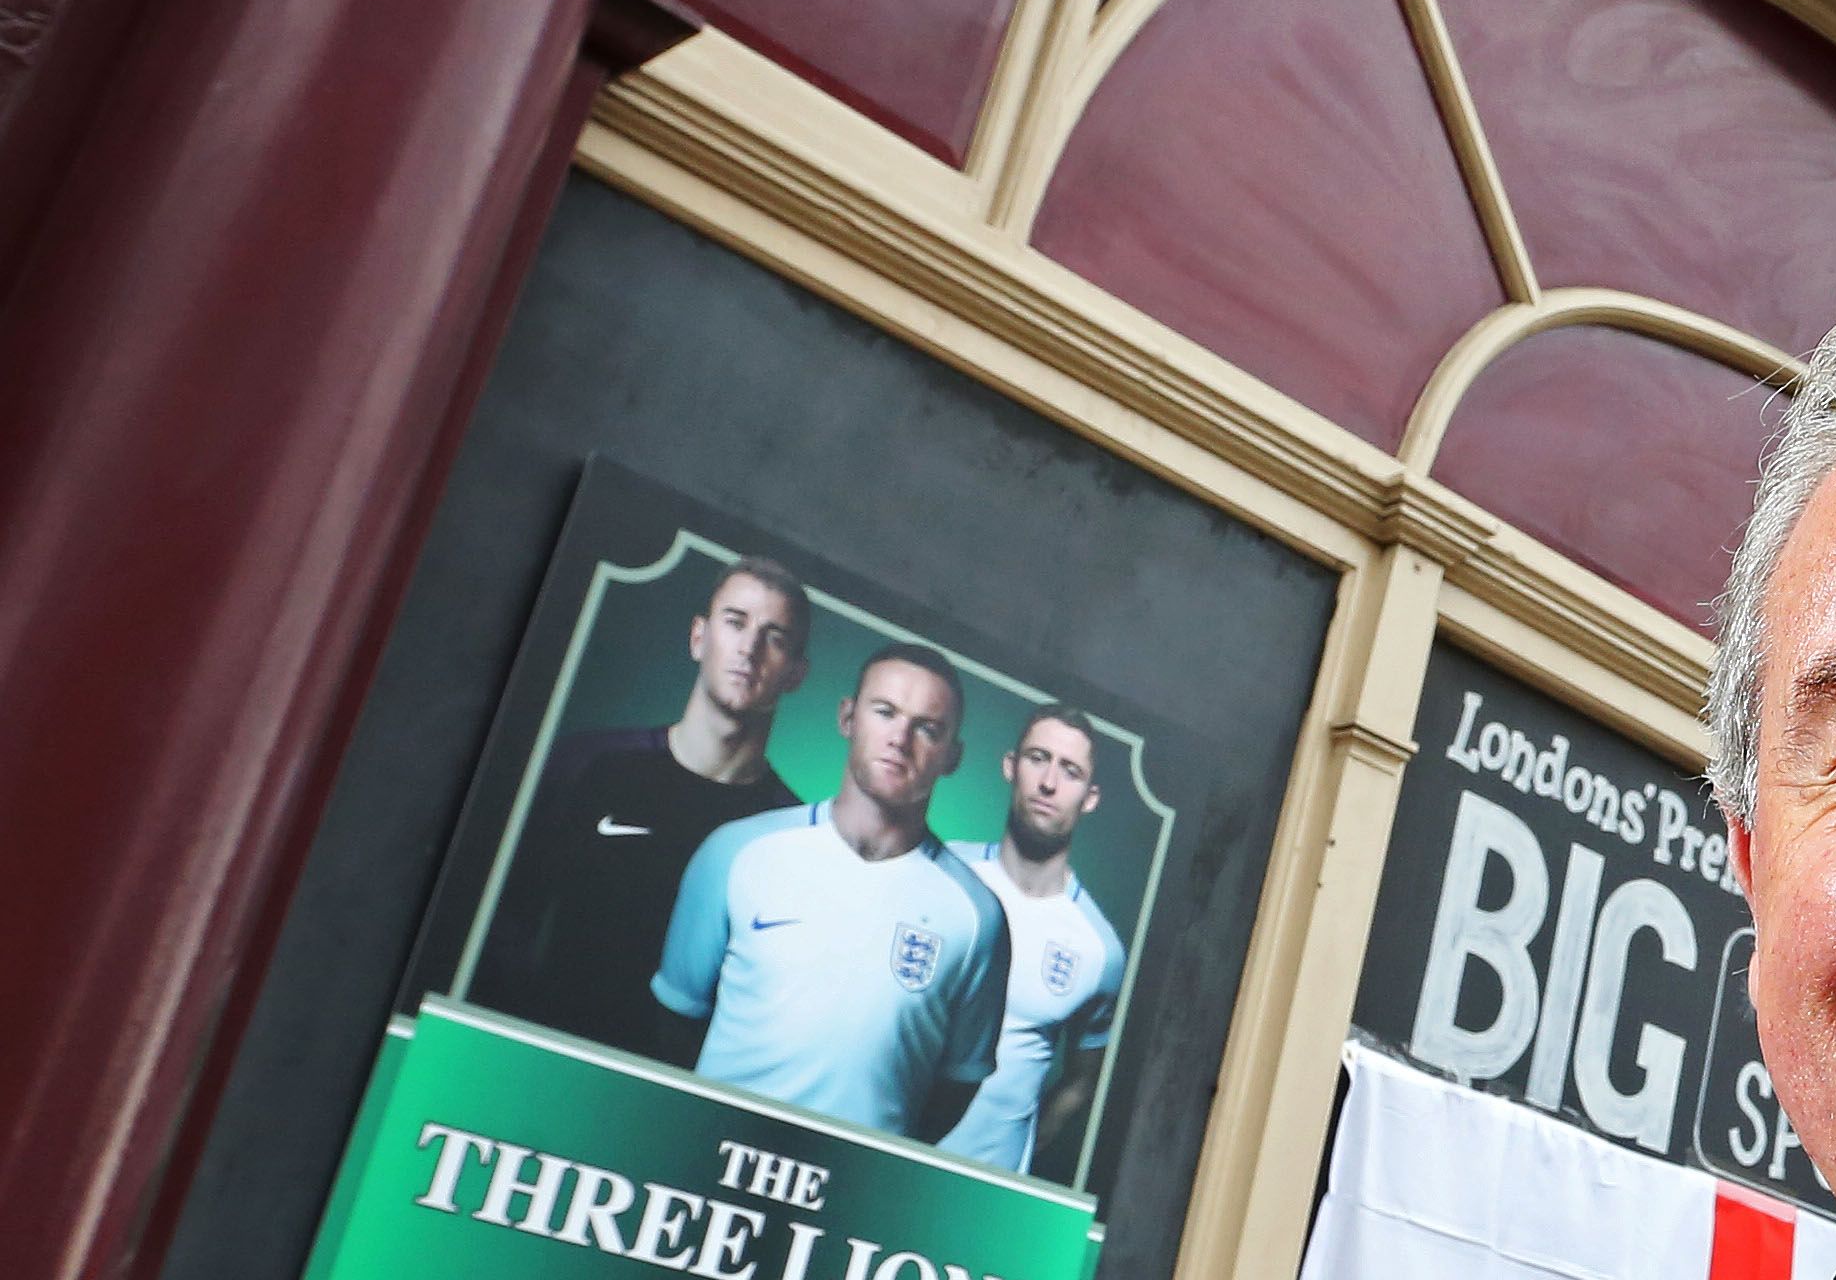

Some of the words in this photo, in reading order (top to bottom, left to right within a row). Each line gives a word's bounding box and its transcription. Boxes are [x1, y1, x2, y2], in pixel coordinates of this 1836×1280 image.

[1652, 786, 1743, 897] Pre
[1411, 790, 1698, 1155] BIG
[717, 1139, 831, 1212] THE
